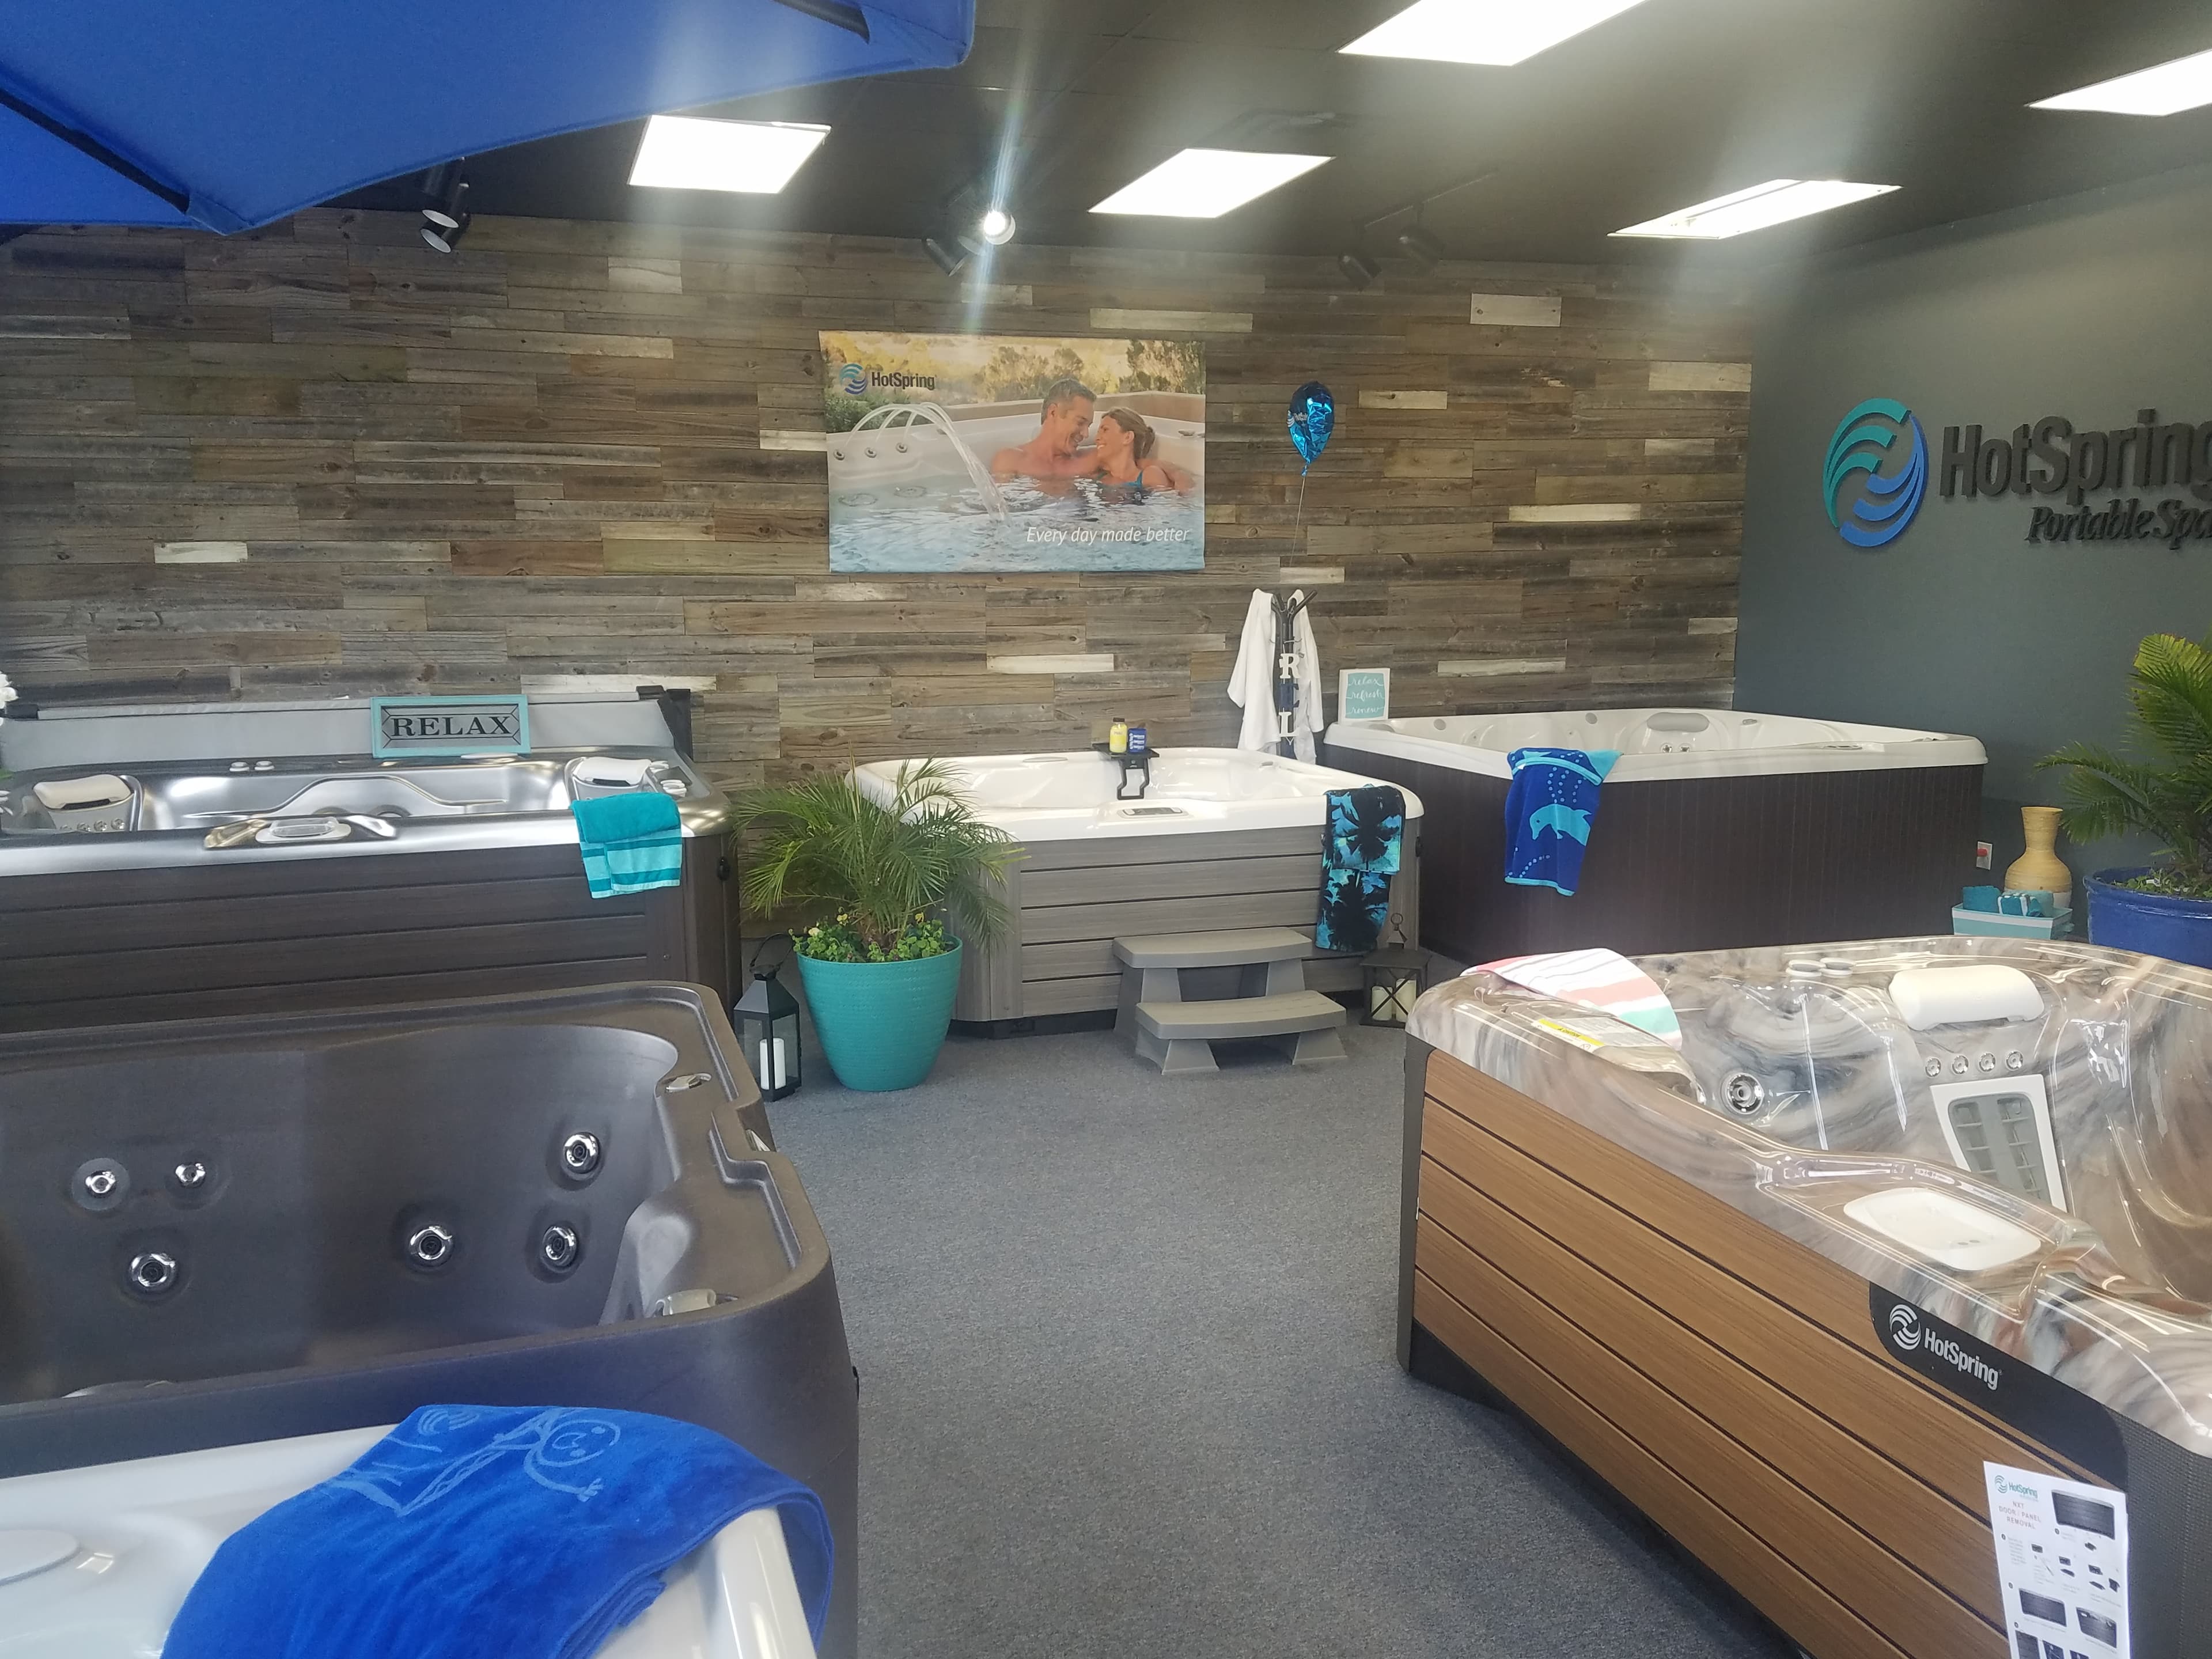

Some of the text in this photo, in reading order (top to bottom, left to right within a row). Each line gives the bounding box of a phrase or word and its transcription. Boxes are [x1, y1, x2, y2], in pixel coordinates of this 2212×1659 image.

[872, 372, 935, 391] HotSpring
[1027, 527, 1190, 546] Every day made better
[1349, 676, 1384, 686] relax
[1346, 689, 1385, 702] refresh
[391, 716, 512, 737] RELAX
[1925, 1327, 1999, 1391] HotSpring
[2009, 1482, 2038, 1498] HotSpring
[1999, 1505, 2016, 1516] DOOR
[2021, 1512, 2041, 1522] PANEL
[2007, 1516, 2036, 1529] REMOVAL
